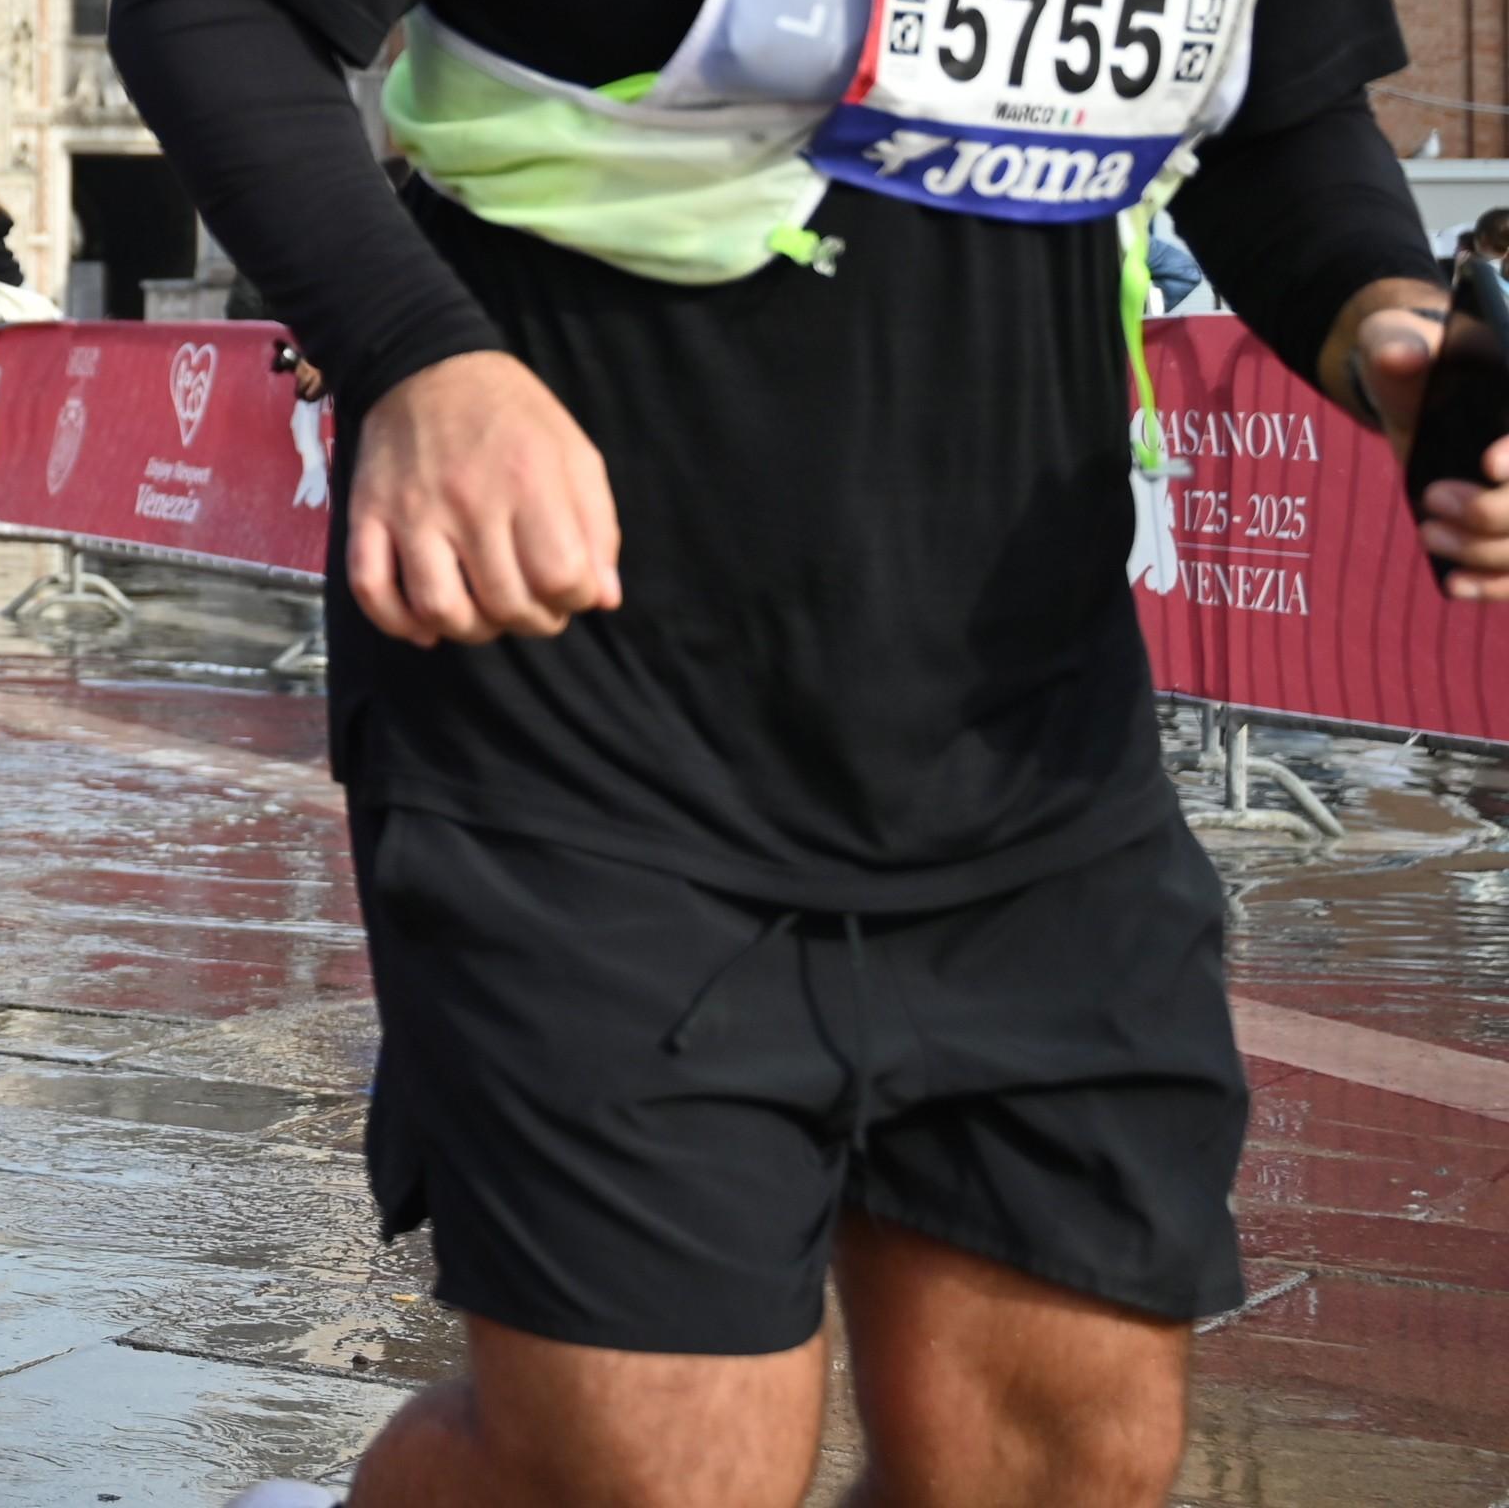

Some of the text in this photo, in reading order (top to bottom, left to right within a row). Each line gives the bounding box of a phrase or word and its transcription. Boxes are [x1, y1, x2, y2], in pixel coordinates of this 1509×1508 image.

[994, 101, 1055, 125] MARCO
[134, 482, 202, 524] Venezia
[1183, 489, 1229, 534] 1725
[1245, 493, 1308, 541] 2025
[1179, 559, 1310, 616] VENEZIA
